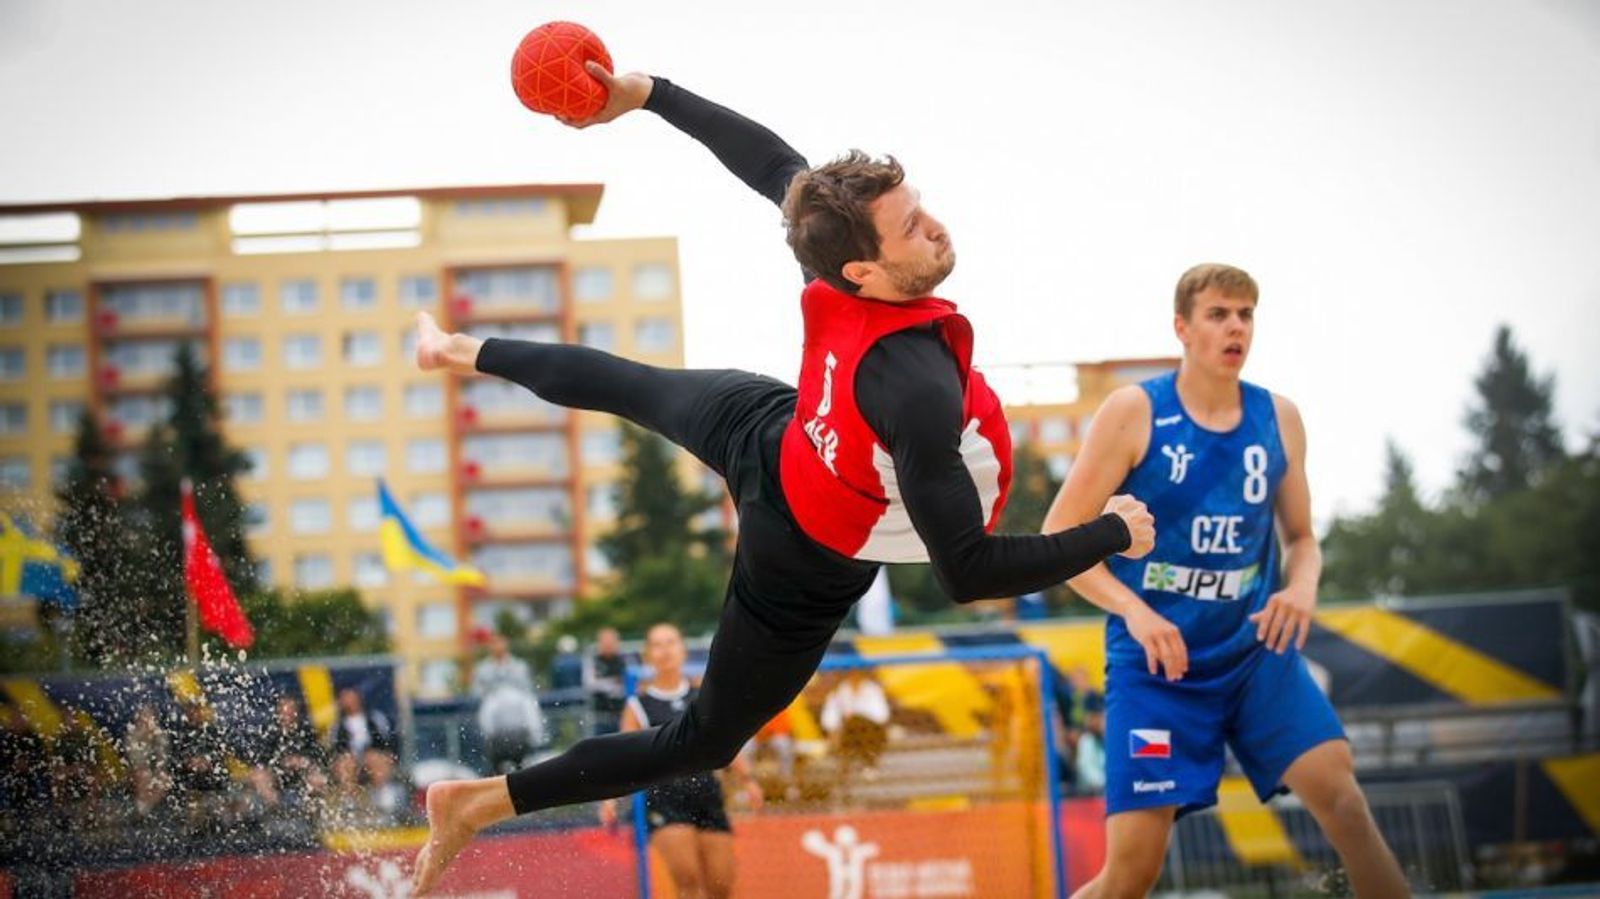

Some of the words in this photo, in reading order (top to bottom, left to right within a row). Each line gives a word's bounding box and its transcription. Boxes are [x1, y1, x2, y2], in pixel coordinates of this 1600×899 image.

[1243, 445, 1268, 504] 8
[1191, 515, 1244, 553] CZE
[1177, 571, 1234, 600] JPL
